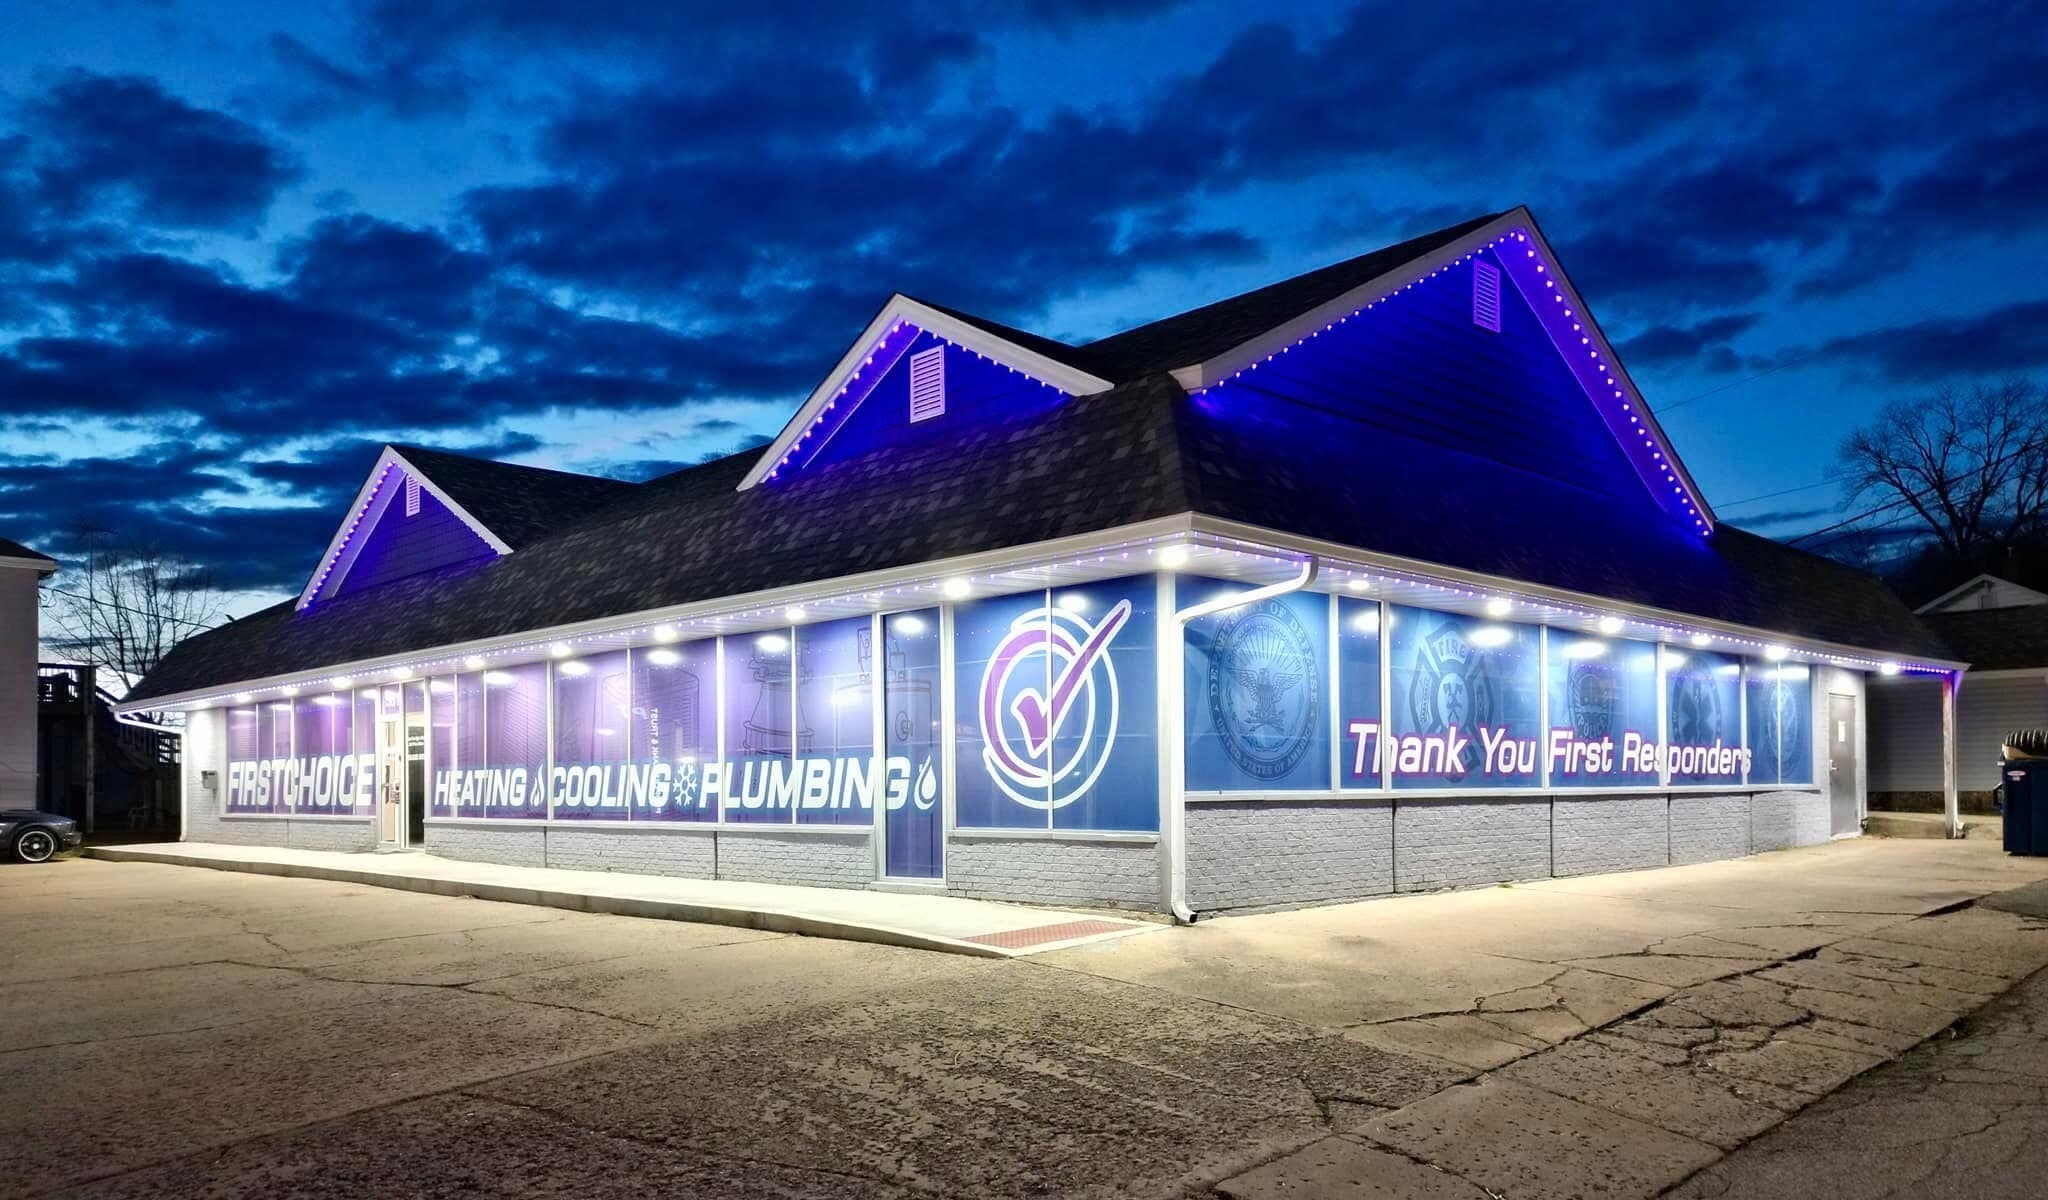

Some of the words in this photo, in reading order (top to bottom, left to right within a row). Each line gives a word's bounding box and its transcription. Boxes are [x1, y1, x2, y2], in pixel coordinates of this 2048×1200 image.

[1437, 638, 1467, 660] FIRE
[1349, 721, 1469, 775] Thank
[1479, 726, 1538, 774] You
[1548, 728, 1615, 775] First
[1621, 731, 1753, 784] Responders
[434, 767, 529, 807] HEATING
[551, 762, 672, 808] COOLING
[698, 756, 912, 811] PLUMBING
